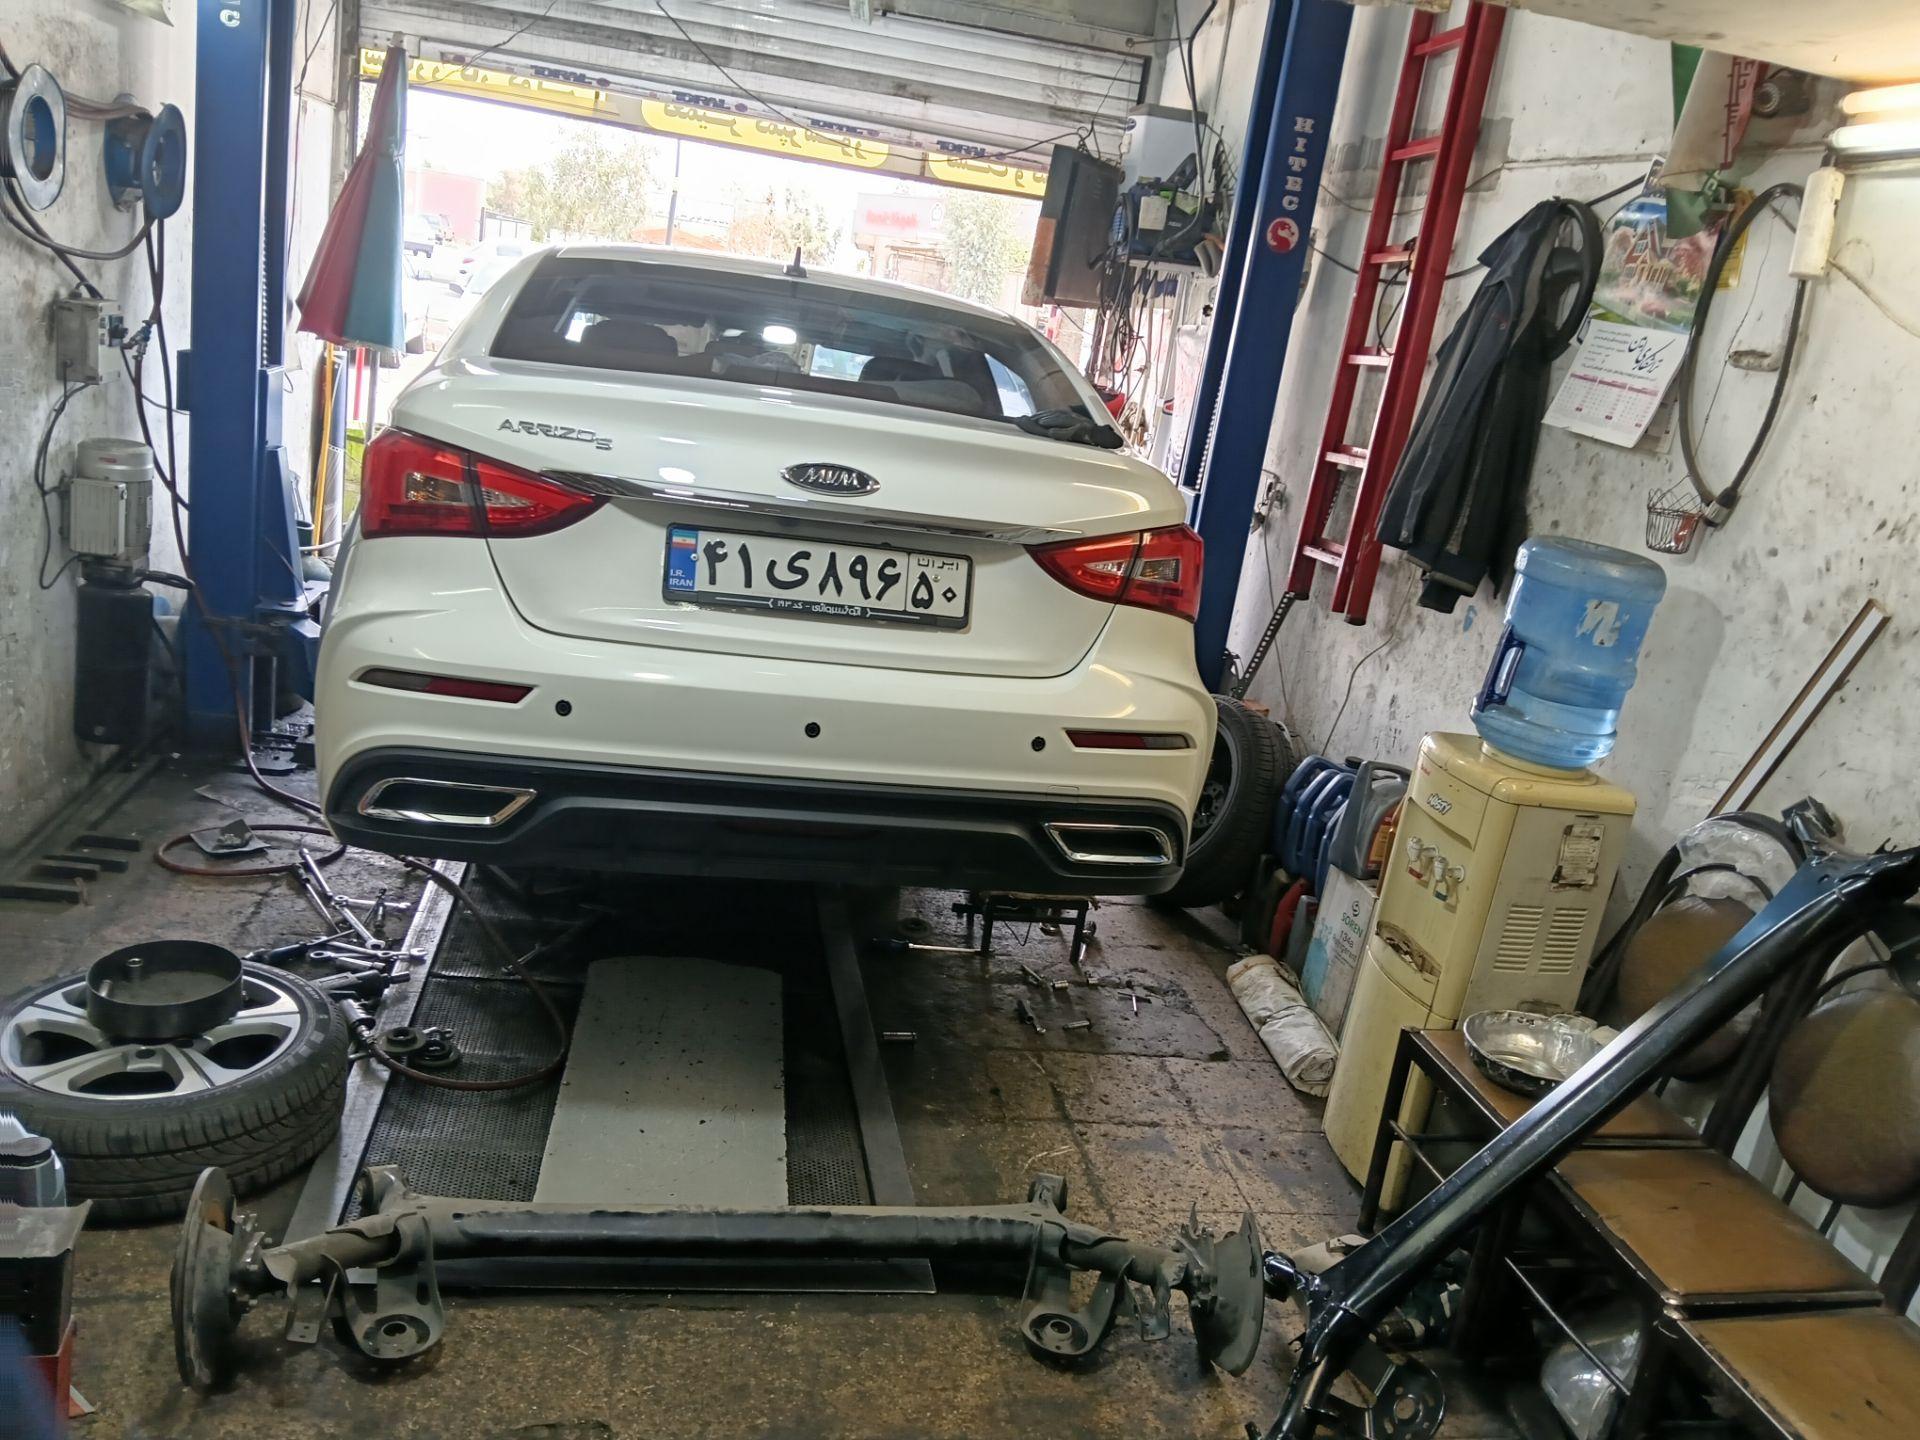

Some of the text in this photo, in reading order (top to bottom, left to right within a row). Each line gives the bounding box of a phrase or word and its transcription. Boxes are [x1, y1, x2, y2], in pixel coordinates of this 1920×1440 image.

[1282, 116, 1315, 211] HITEC
[496, 418, 596, 443] ARRIZO
[669, 578, 694, 587] IRAN
[1341, 912, 1363, 938] SOREN
